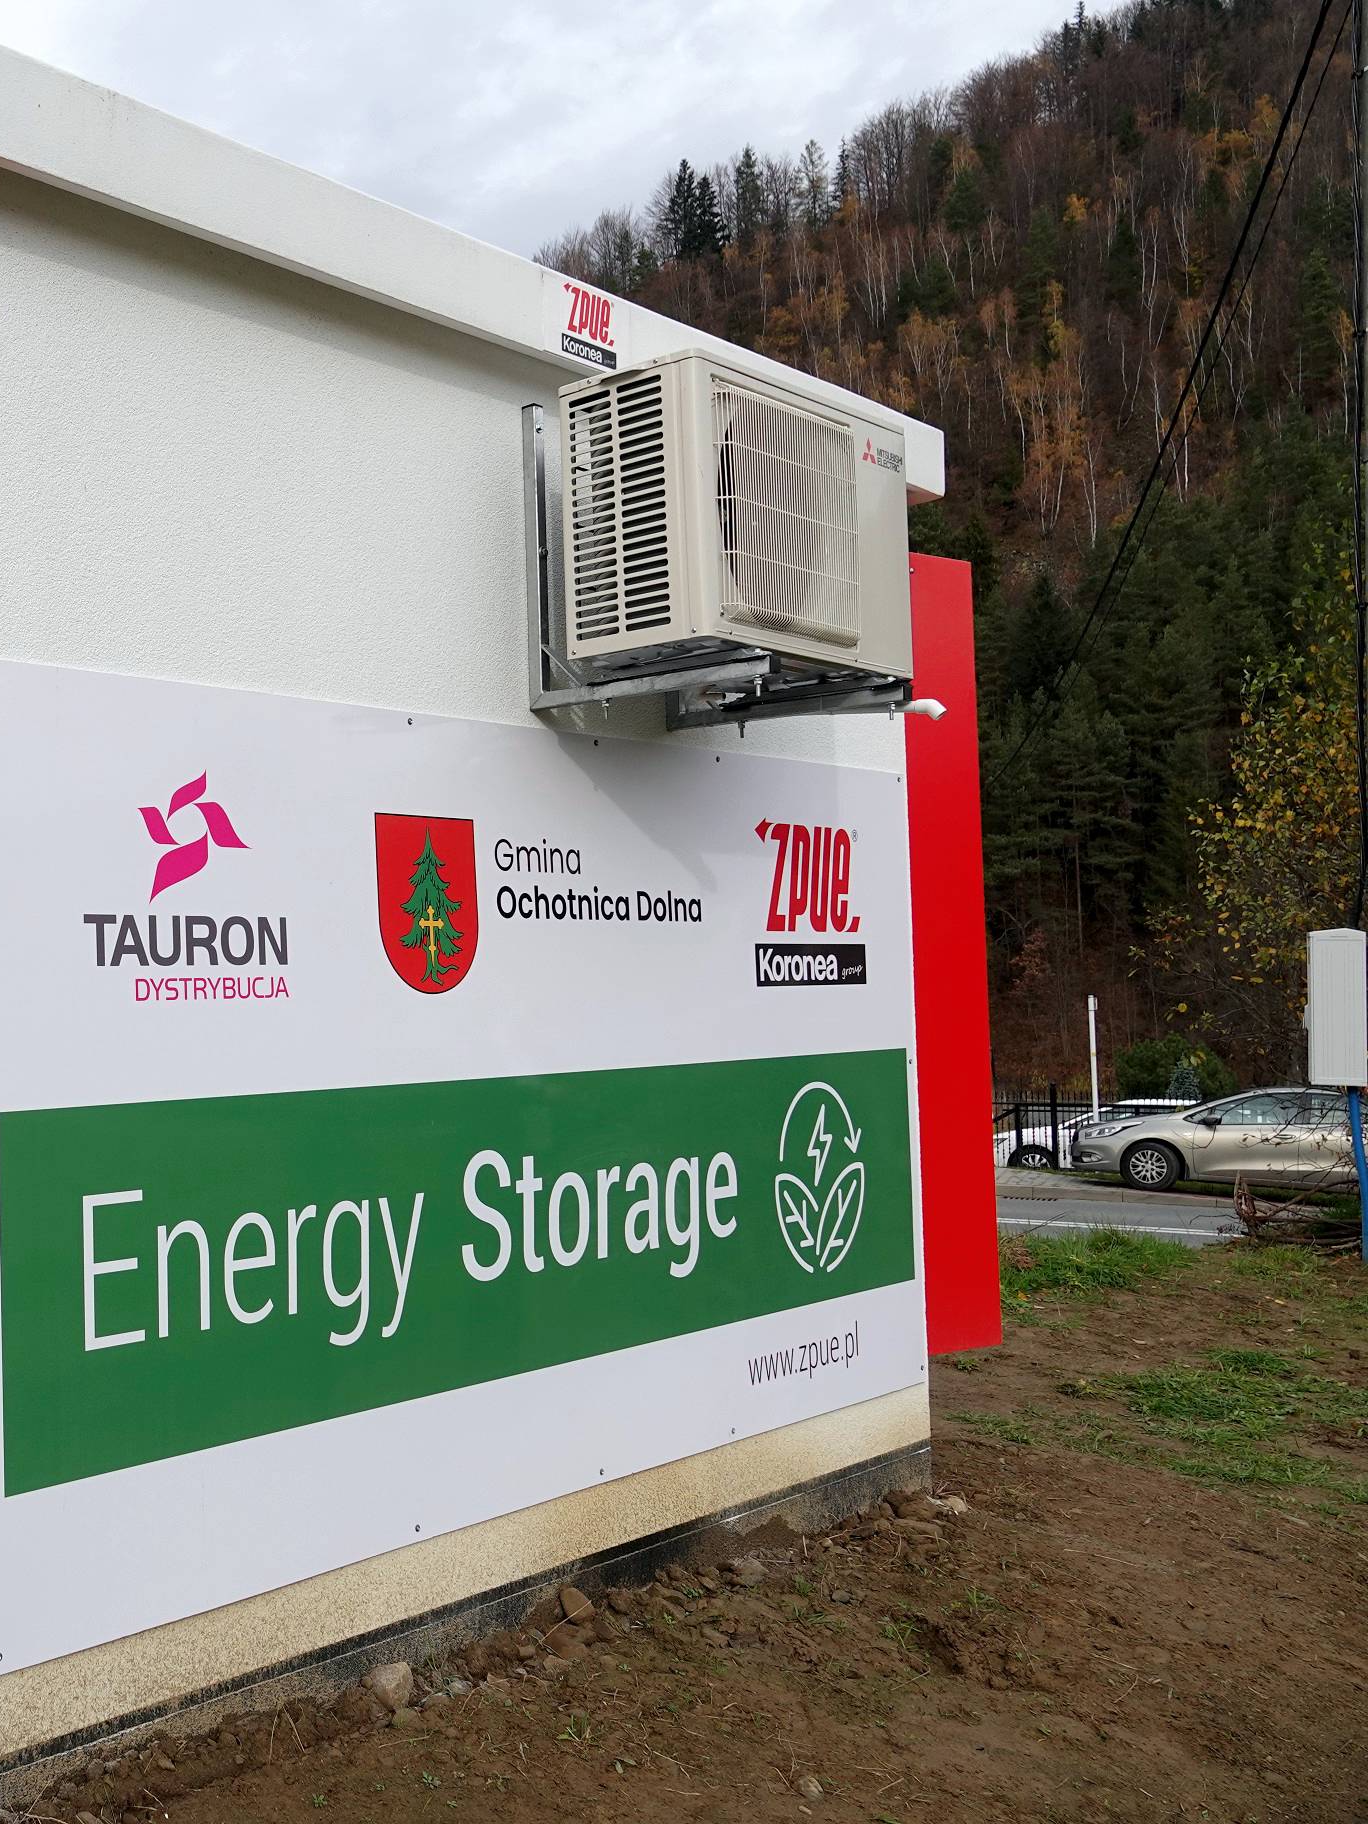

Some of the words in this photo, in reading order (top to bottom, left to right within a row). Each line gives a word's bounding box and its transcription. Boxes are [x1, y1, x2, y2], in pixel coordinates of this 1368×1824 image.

[563, 335, 602, 363] Koronea
[877, 457, 900, 473] ELECTRIC
[495, 839, 580, 875] Gmina
[497, 885, 631, 922] Ochotnica
[637, 889, 702, 923] Dolna
[84, 914, 288, 967] TAURON
[759, 949, 838, 982] Koronea
[841, 964, 863, 980] group
[136, 976, 289, 1002] DYSTRYBUCJA
[83, 1190, 424, 1351] Energy
[462, 1150, 738, 1282] Storage
[747, 1320, 861, 1387] www.zpue.pl
